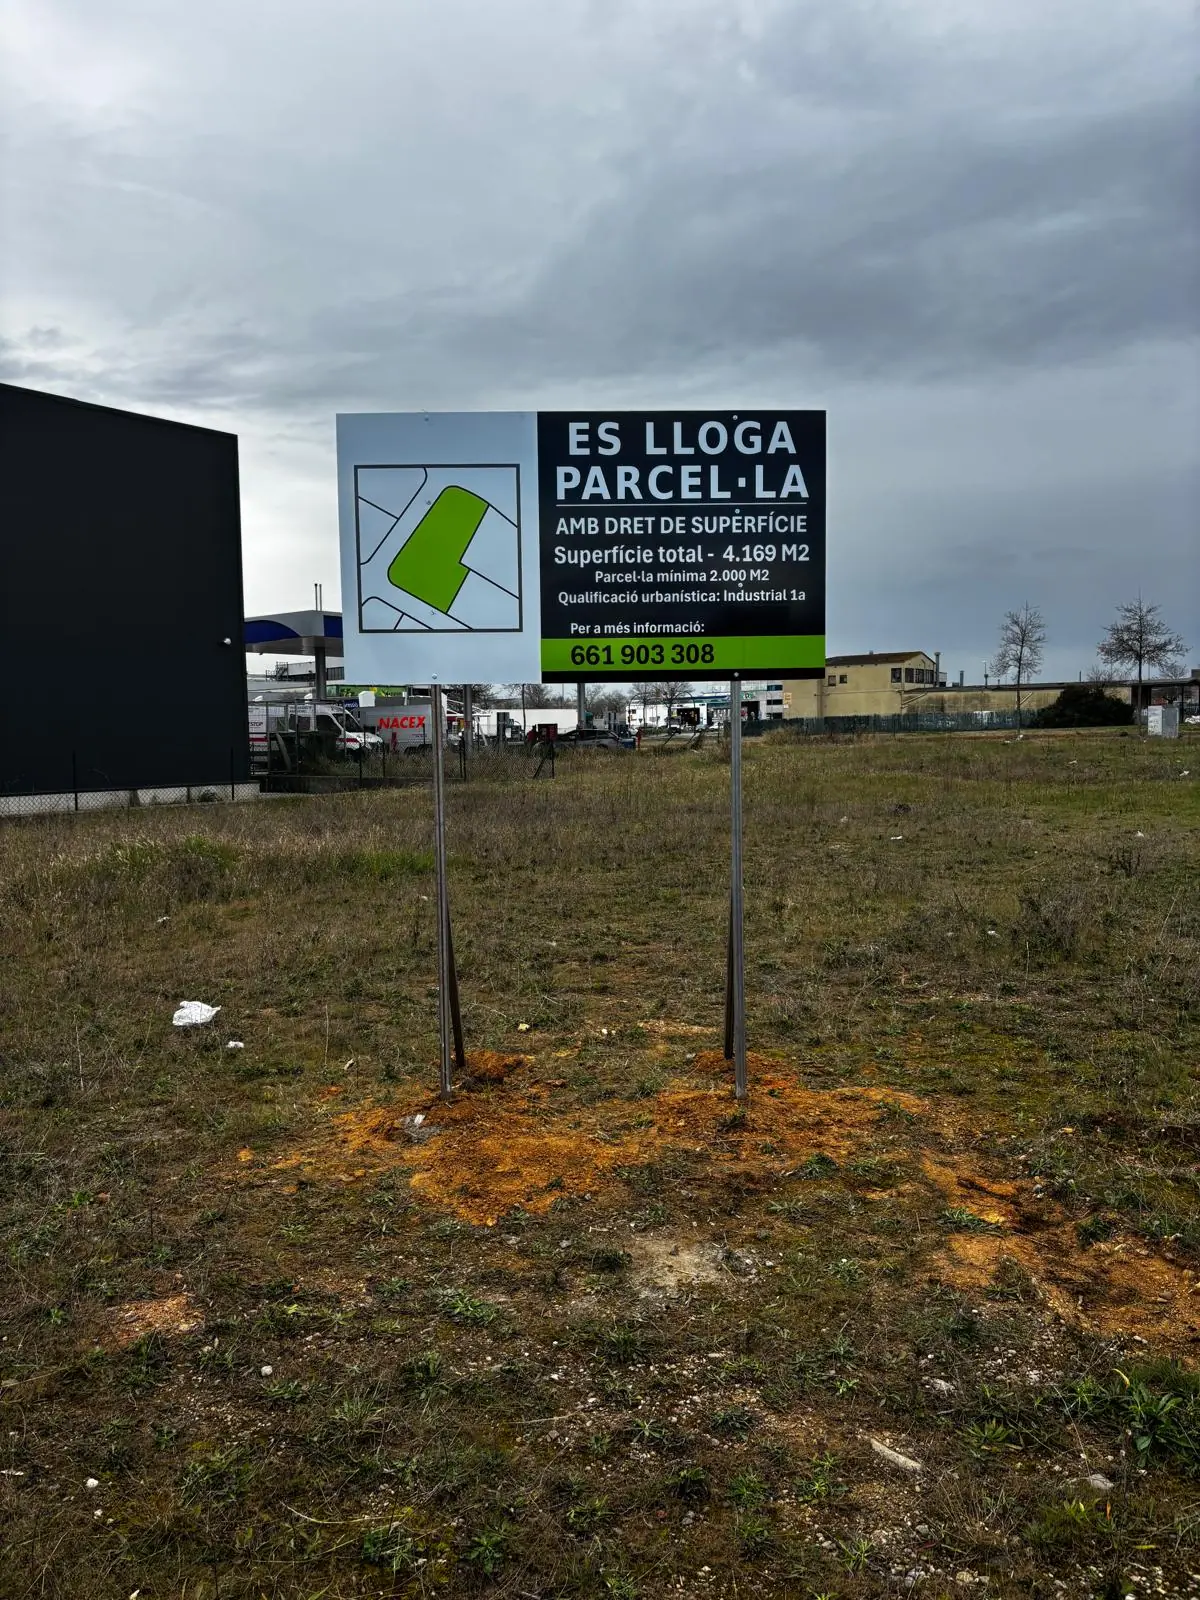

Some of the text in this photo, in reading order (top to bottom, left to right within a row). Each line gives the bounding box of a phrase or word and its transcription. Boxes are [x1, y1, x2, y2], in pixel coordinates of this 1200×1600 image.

[569, 421, 796, 455] ES LLOGA
[556, 512, 807, 534] AMB DRET DE SUPERFÍCIE
[554, 546, 653, 567] Superfície
[659, 545, 703, 563] total
[723, 544, 776, 562] 4.169
[782, 544, 809, 561] M2
[657, 570, 706, 582] mínima
[710, 570, 746, 581] 2.000
[750, 570, 769, 581] M2
[558, 589, 805, 605] Qualificació urbanística: Industrial 1a
[571, 623, 590, 633] Per
[604, 622, 630, 633] més
[633, 621, 704, 633] informació:
[571, 644, 715, 665] 661 903 308
[379, 716, 426, 730] NACEX
